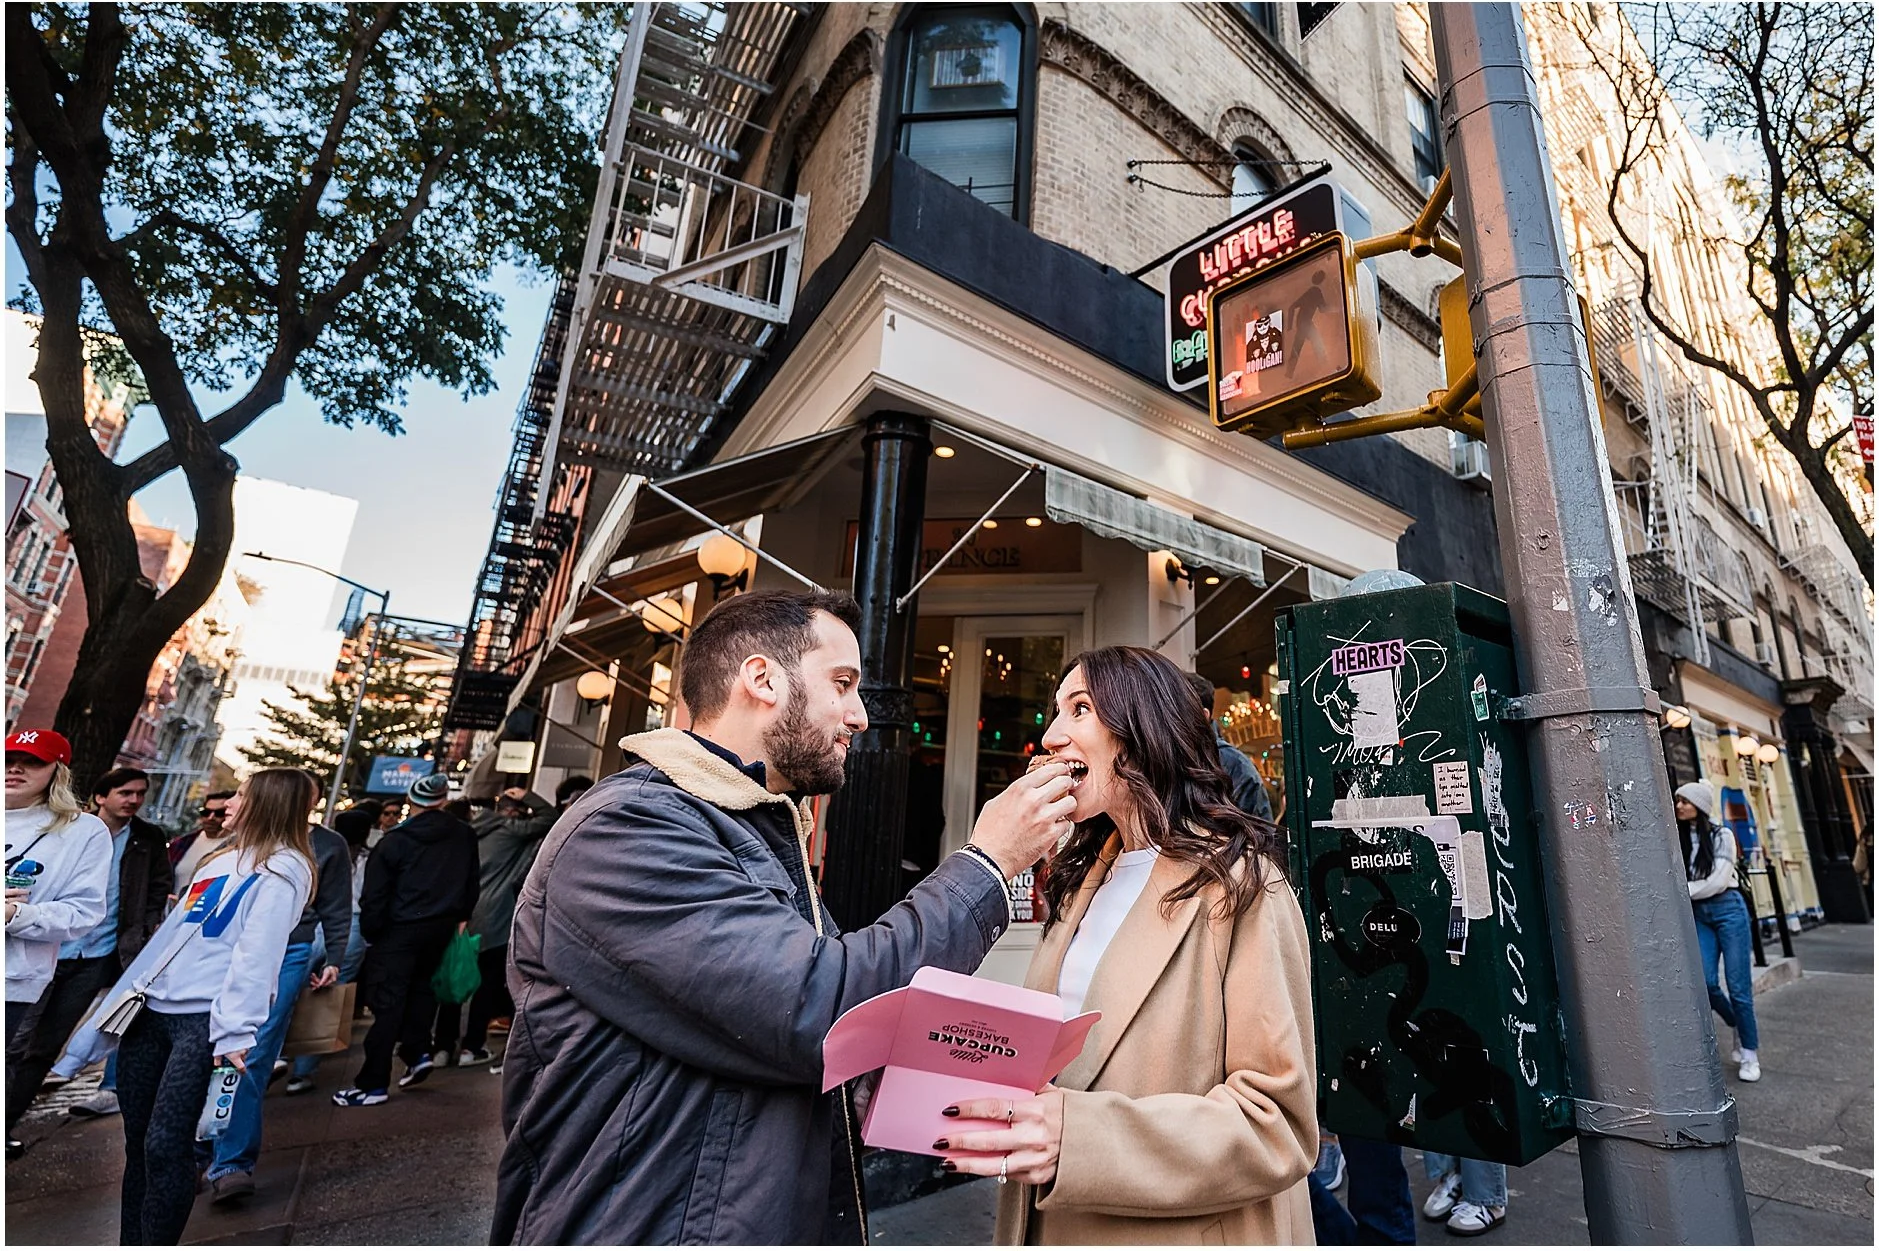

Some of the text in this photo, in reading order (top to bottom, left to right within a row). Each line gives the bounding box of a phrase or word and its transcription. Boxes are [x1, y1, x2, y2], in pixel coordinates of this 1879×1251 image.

[1199, 209, 1295, 281] LITTLE
[1336, 641, 1402, 672] HEARTS
[1351, 852, 1412, 869] BRIGADE
[1370, 922, 1398, 932] DELU
[928, 1031, 1018, 1058] CUPCAKE
[942, 1024, 1010, 1045] BAKESHOP
[949, 1048, 988, 1064] Little
[215, 1073, 239, 1119] core
